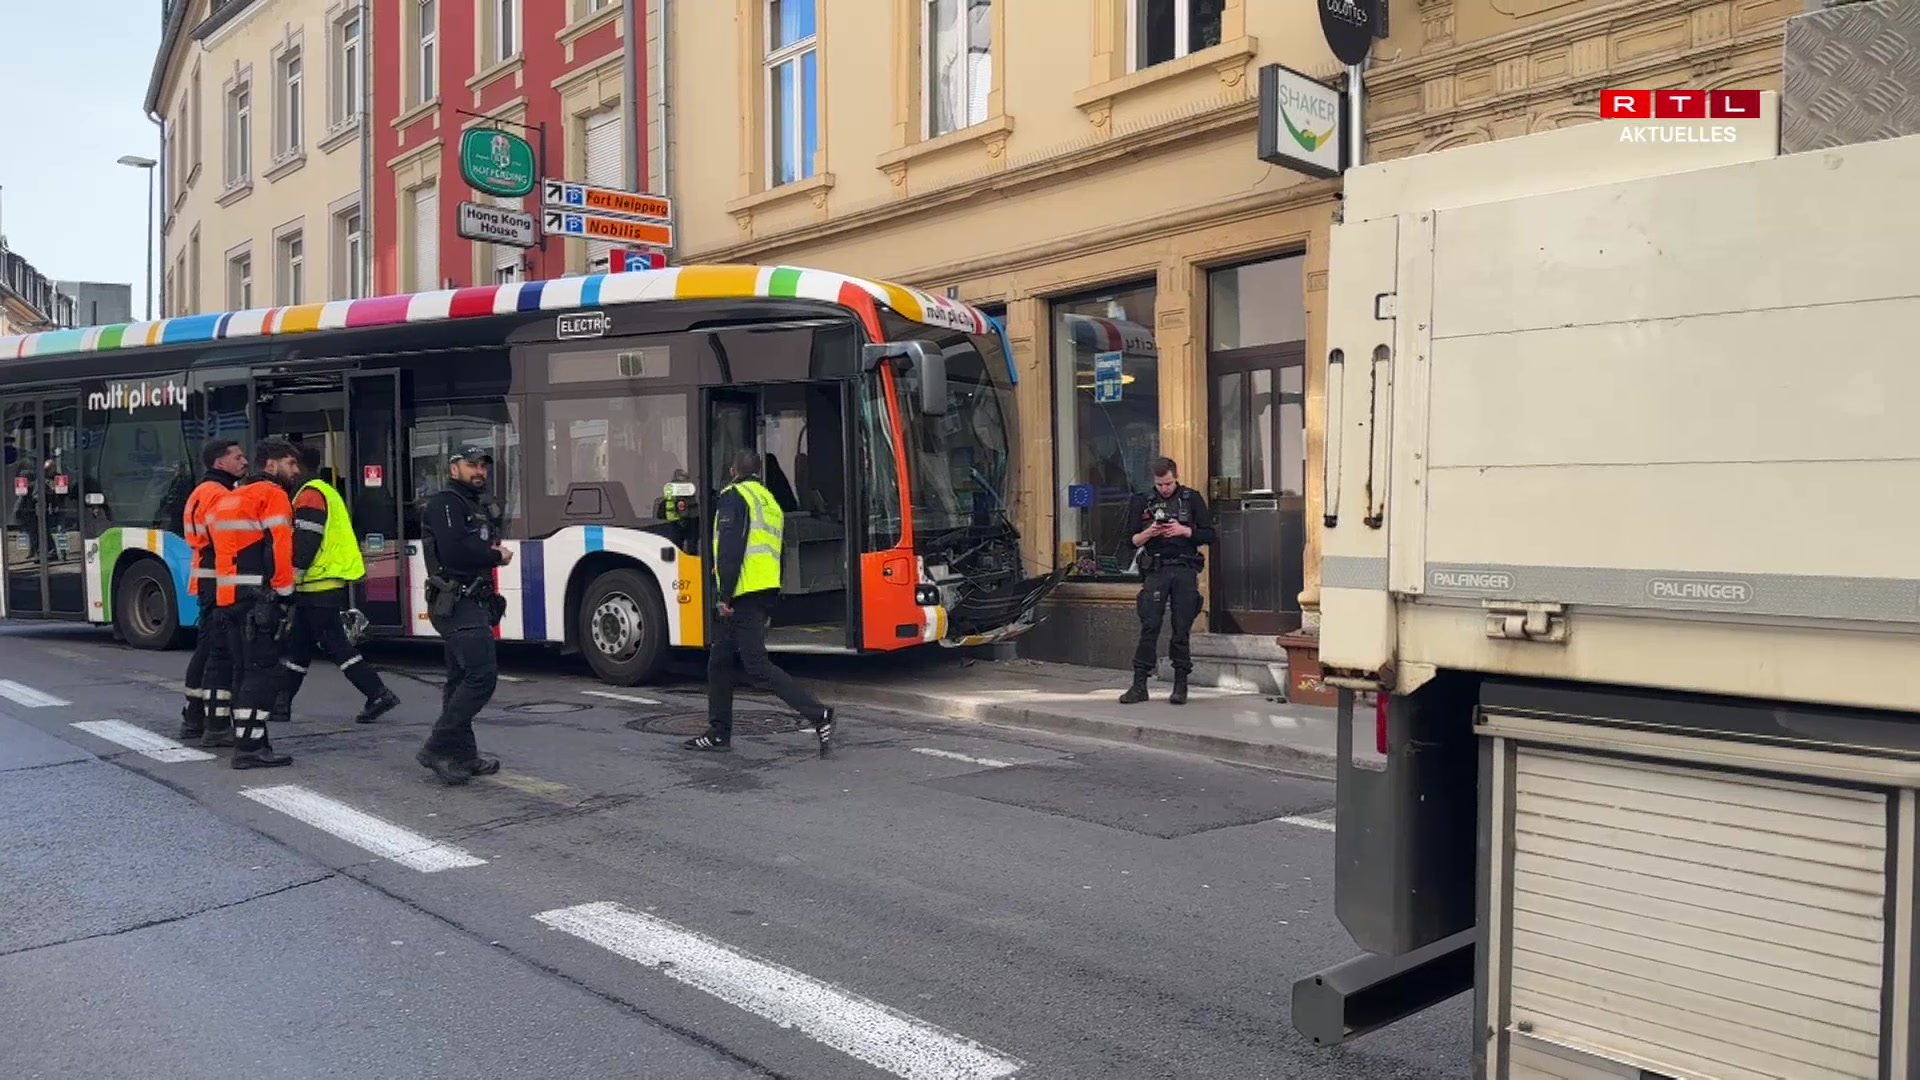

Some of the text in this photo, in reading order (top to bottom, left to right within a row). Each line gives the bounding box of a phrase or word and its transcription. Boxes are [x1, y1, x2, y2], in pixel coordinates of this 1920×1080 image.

[1279, 84, 1336, 122] SHAKER
[586, 191, 611, 206] Fort
[614, 197, 669, 216] Neipperg
[467, 208, 531, 230] Hong Kong
[480, 223, 518, 238] House
[589, 221, 641, 239] Nobilis
[560, 317, 611, 332] ELECTRIC
[88, 379, 187, 415] multiplicity
[1433, 572, 1509, 589] PALFINGER
[1653, 581, 1745, 599] PALFINGER
